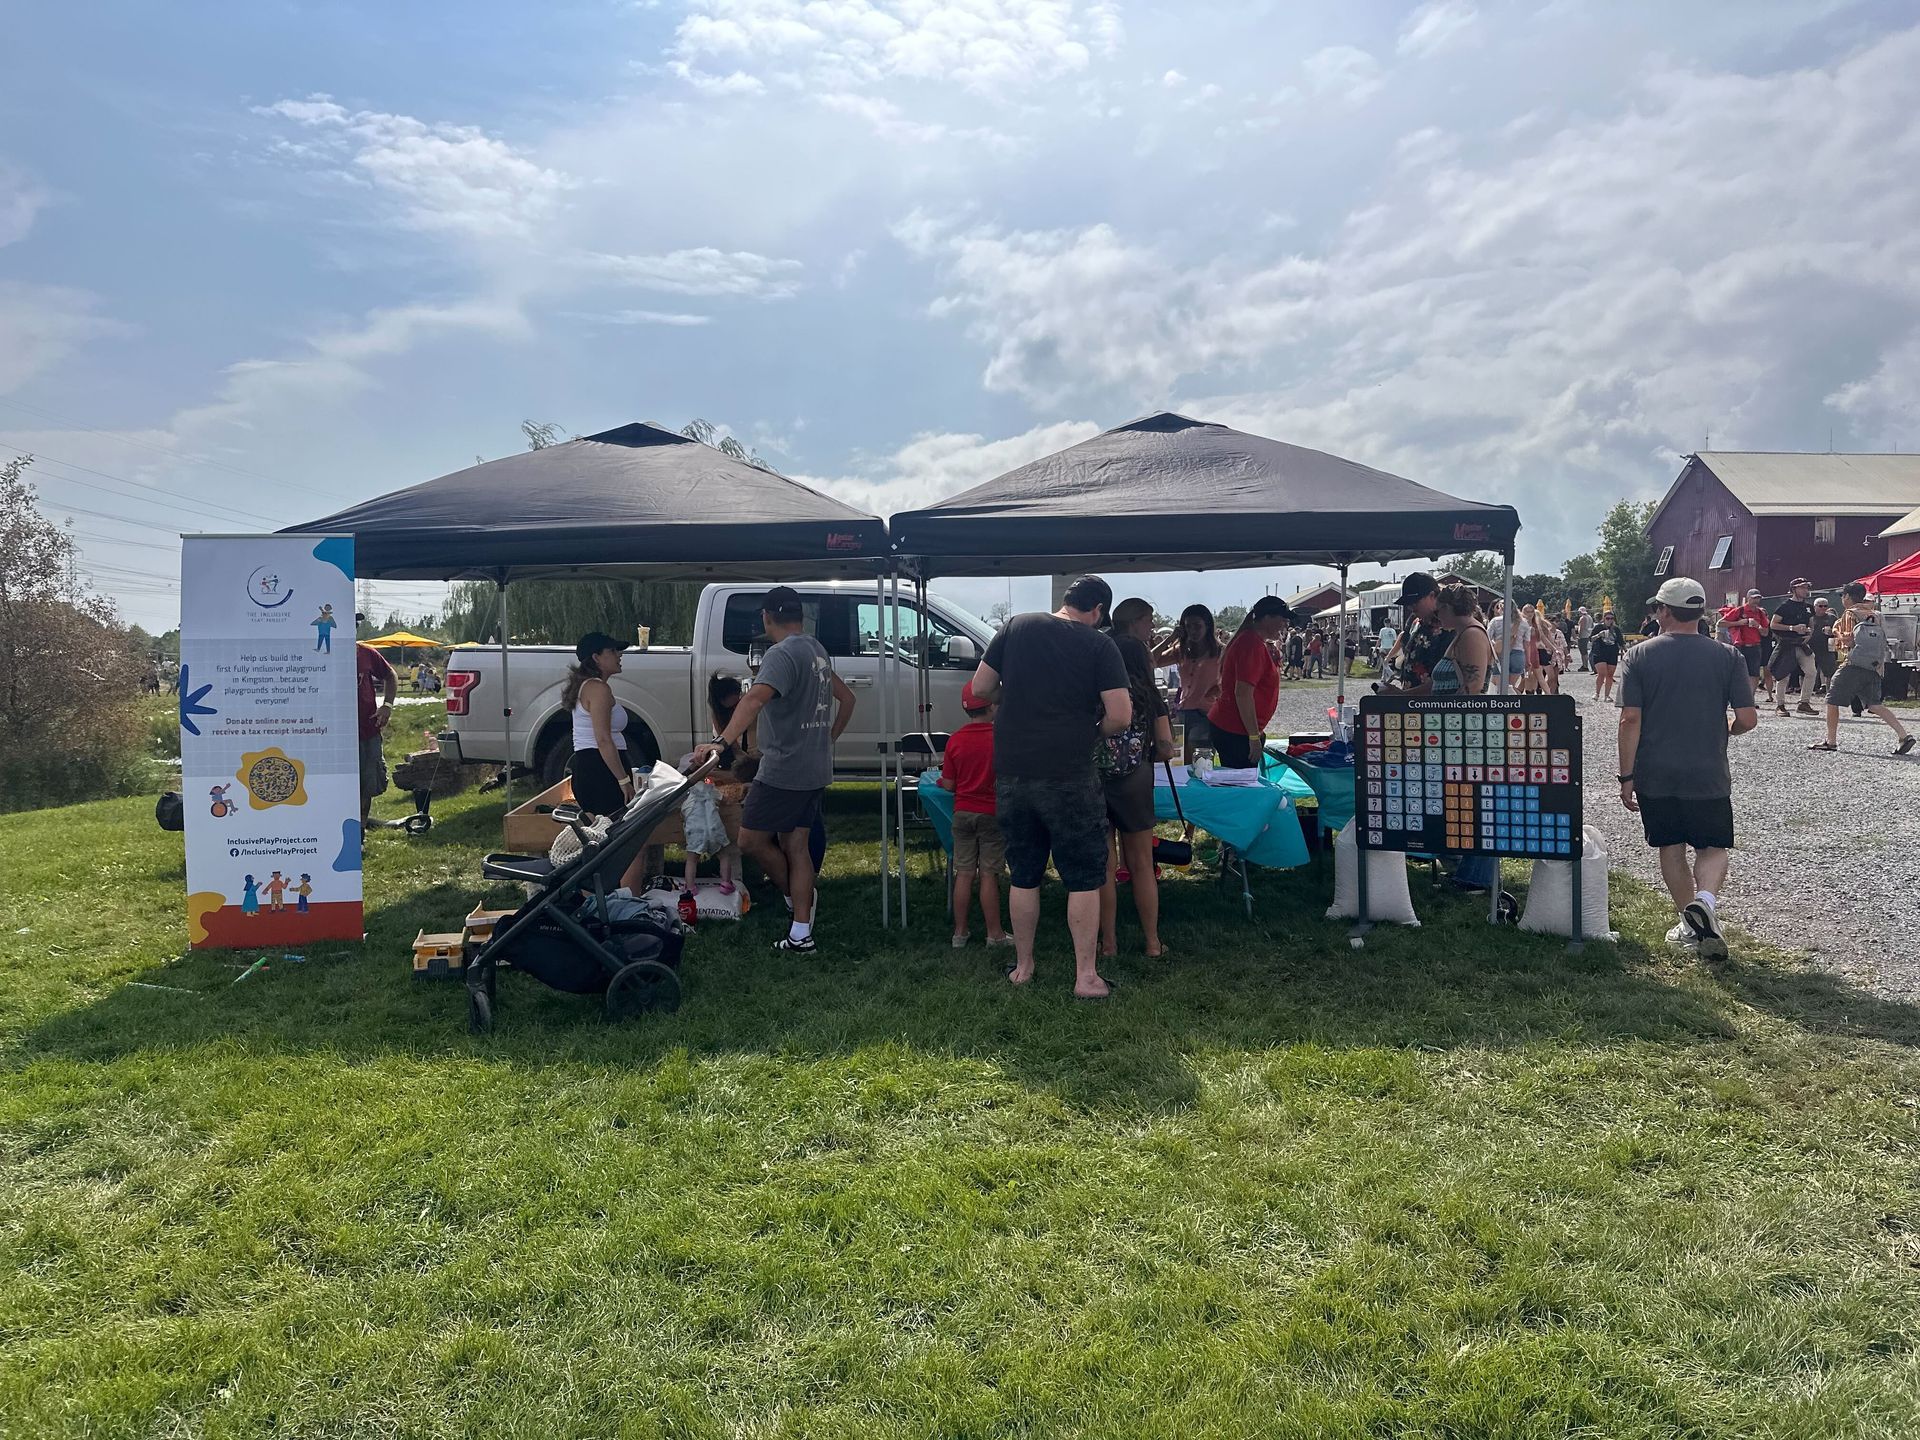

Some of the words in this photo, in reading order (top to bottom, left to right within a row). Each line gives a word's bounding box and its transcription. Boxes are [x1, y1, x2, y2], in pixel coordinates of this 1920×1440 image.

[234, 665, 250, 674] fully
[286, 665, 326, 674] playground
[224, 687, 268, 695] playgrounds
[255, 698, 289, 706] everyone!
[1408, 700, 1488, 709] Communication
[1490, 700, 1521, 708] Board
[292, 727, 328, 735] instantly!
[227, 837, 318, 845] InclusivePlayProject.com
[241, 848, 317, 856] /InclusivePlayProject
[696, 908, 731, 916] ENTATION
